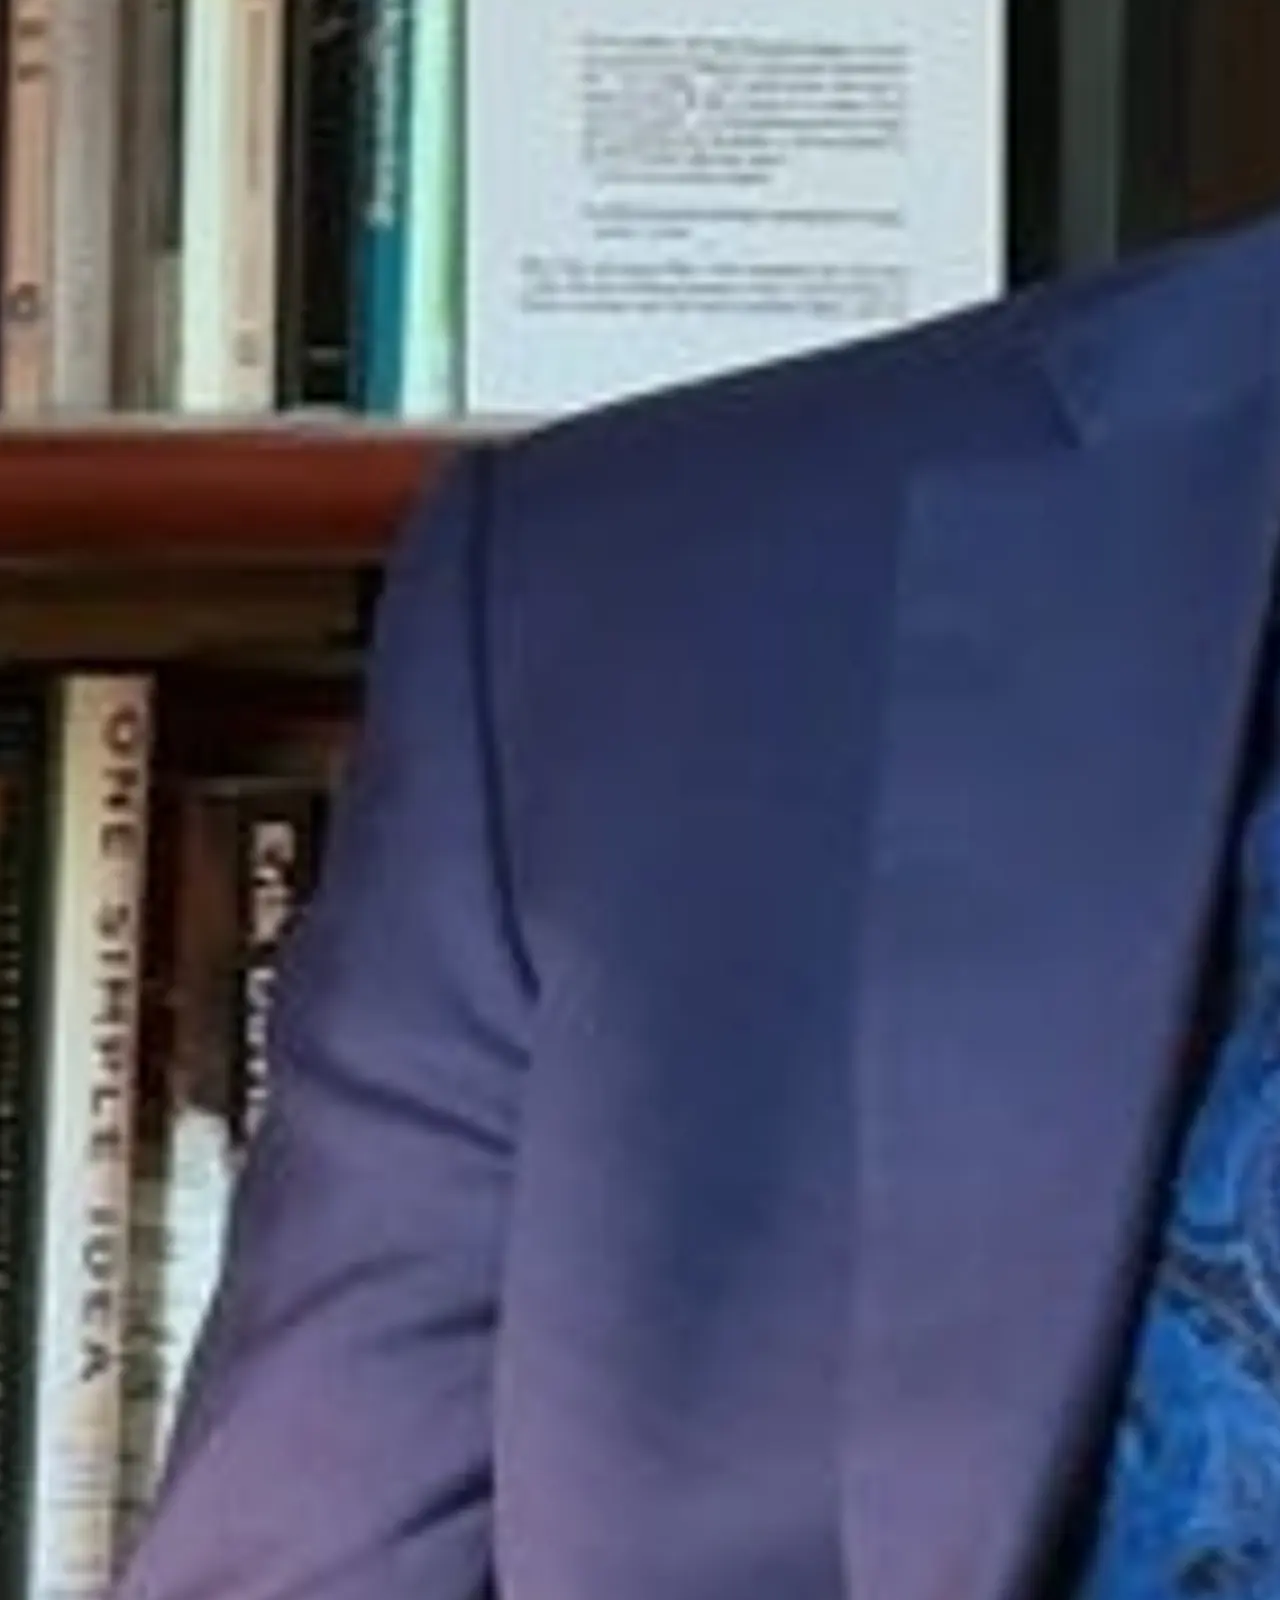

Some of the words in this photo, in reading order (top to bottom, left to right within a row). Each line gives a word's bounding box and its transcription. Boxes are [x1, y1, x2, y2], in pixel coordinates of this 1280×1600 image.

[100, 707, 141, 860] ONE
[86, 904, 133, 1158] SIMPLE
[77, 1206, 116, 1383] IDEA
